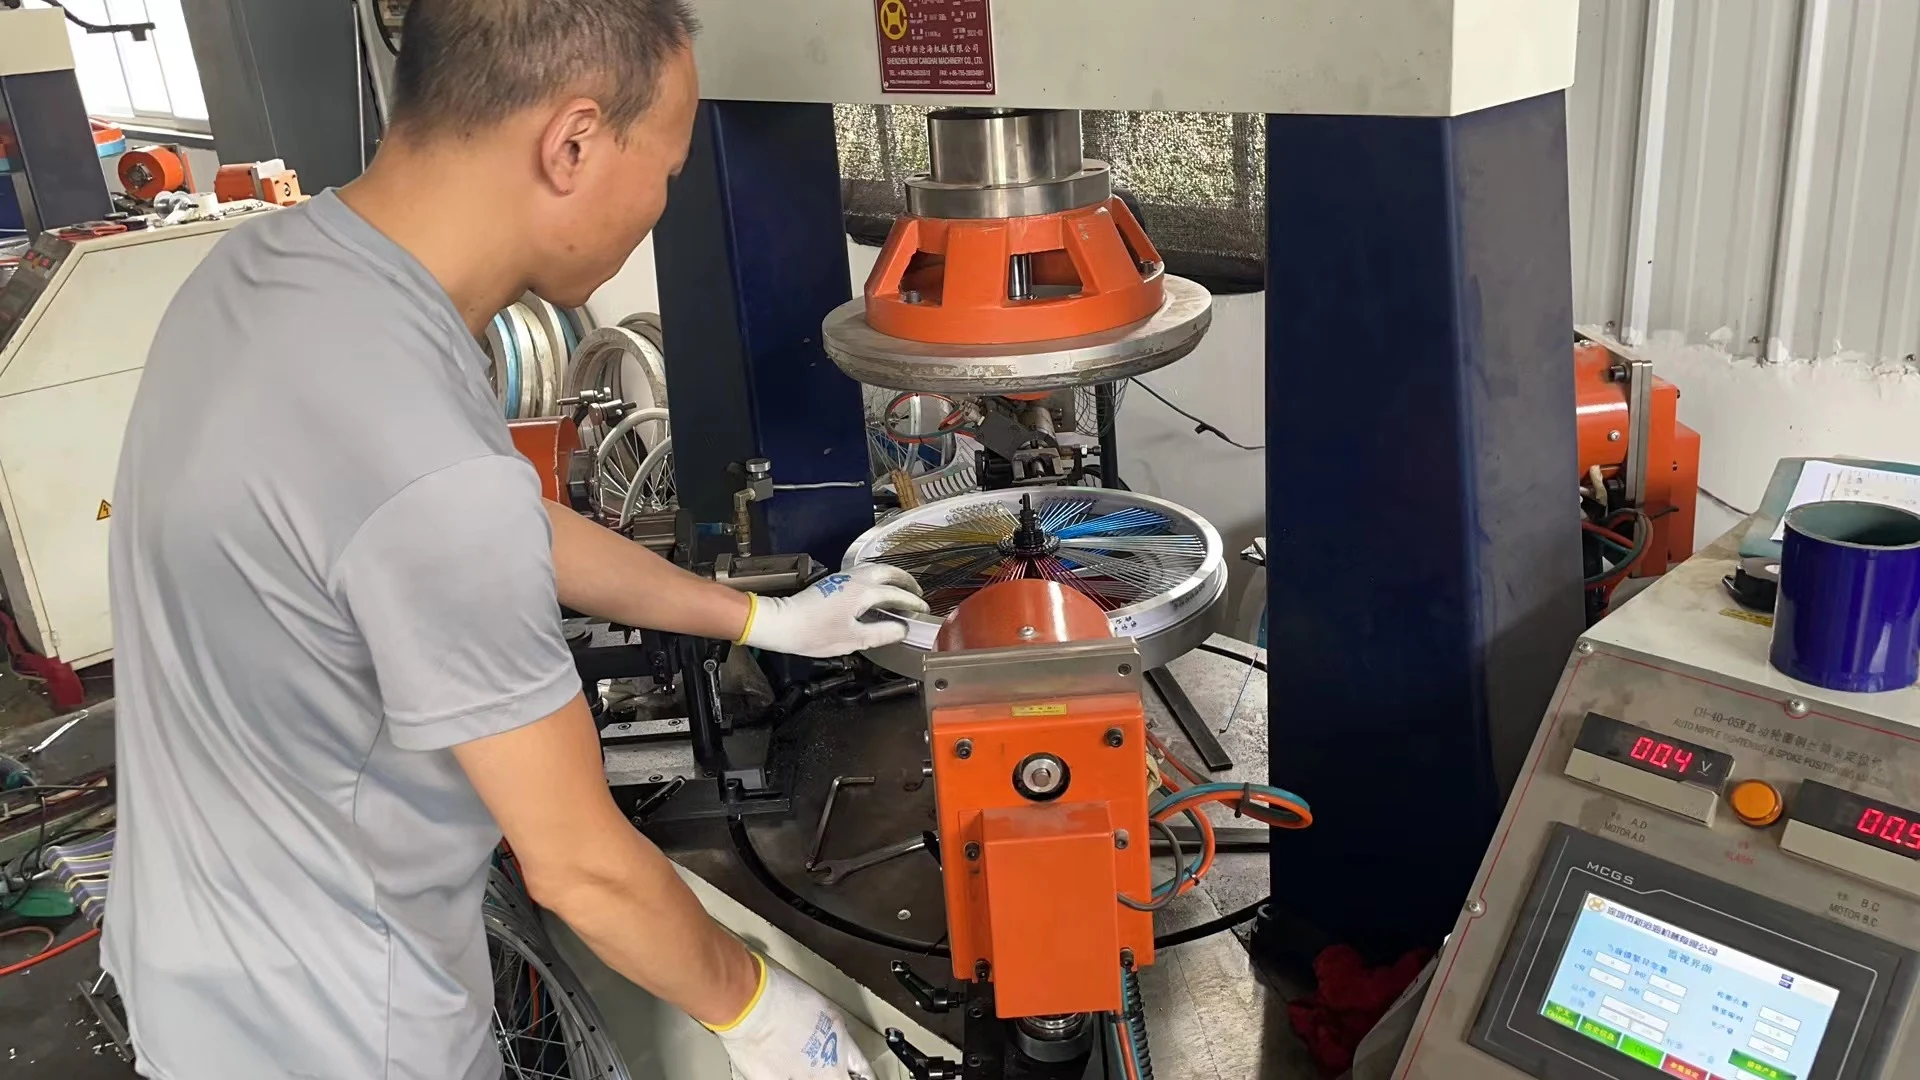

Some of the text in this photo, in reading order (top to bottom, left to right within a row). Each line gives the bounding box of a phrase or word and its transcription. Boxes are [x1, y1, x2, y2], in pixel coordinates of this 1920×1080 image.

[887, 57, 909, 65] SHENZHEN
[909, 57, 918, 65] NEW
[938, 57, 963, 65] MACHINERY
[1672, 717, 1694, 731] AUTO
[1775, 747, 1803, 764] SPOKE
[1630, 736, 1693, 772] 00.4
[1601, 820, 1630, 837] MOTOR
[1586, 861, 1634, 885] MCGS
[1827, 902, 1860, 921] MOTOR
